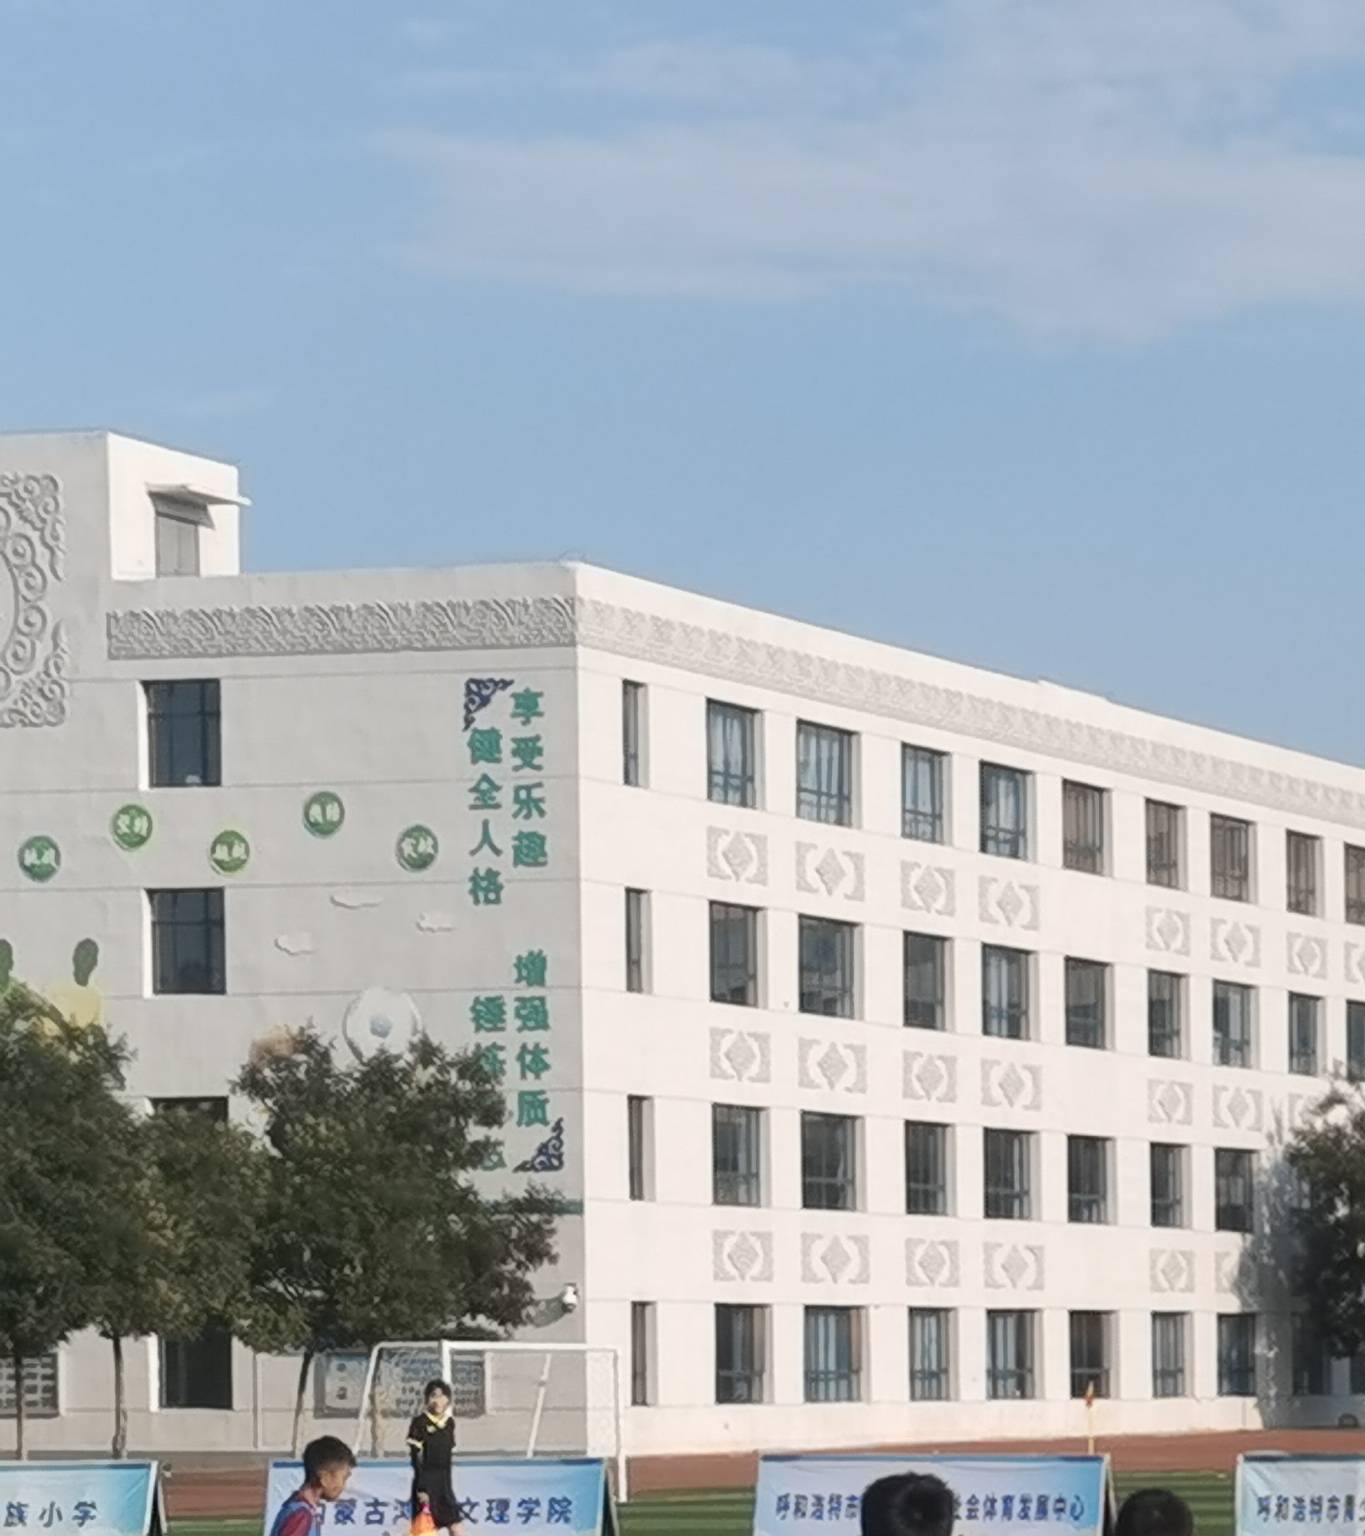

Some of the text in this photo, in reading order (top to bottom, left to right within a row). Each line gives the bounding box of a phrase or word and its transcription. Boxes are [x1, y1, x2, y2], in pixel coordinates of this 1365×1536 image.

[467, 726, 505, 907] 健全人格
[510, 687, 552, 1128] 享受乐趣 增强体质
